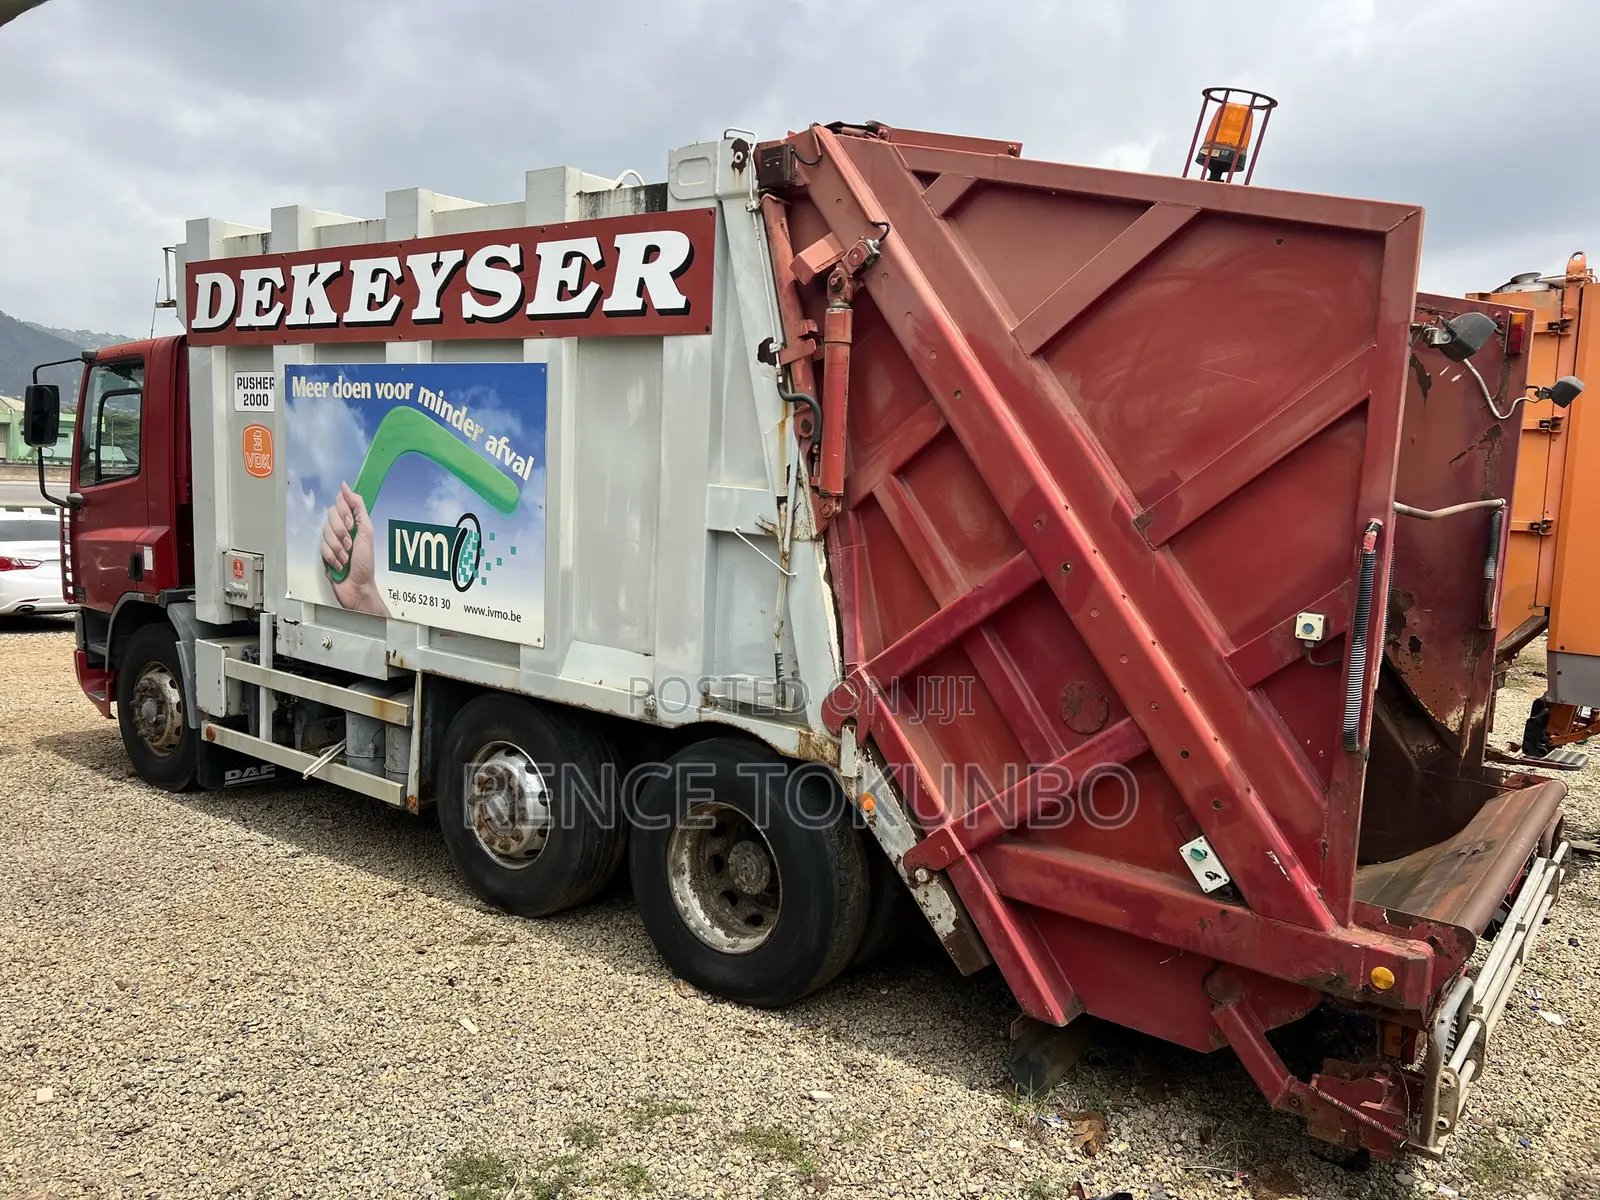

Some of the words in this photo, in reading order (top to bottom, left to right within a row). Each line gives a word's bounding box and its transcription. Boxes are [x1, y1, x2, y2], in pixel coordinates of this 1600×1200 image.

[191, 229, 693, 333] DEKEYSER
[236, 376, 275, 390] PUSHER
[243, 393, 269, 407] 2000
[292, 376, 330, 398] Meer
[332, 375, 372, 399] doen
[374, 382, 414, 400] voor
[417, 386, 485, 441] minder
[485, 434, 535, 482] afval
[388, 588, 401, 601] Tel.
[402, 591, 416, 604] 056
[418, 594, 428, 606] 52
[429, 596, 439, 608] 81
[440, 597, 451, 610] 30
[463, 604, 522, 623] www.ivmo.be
[224, 764, 276, 781] DAF
